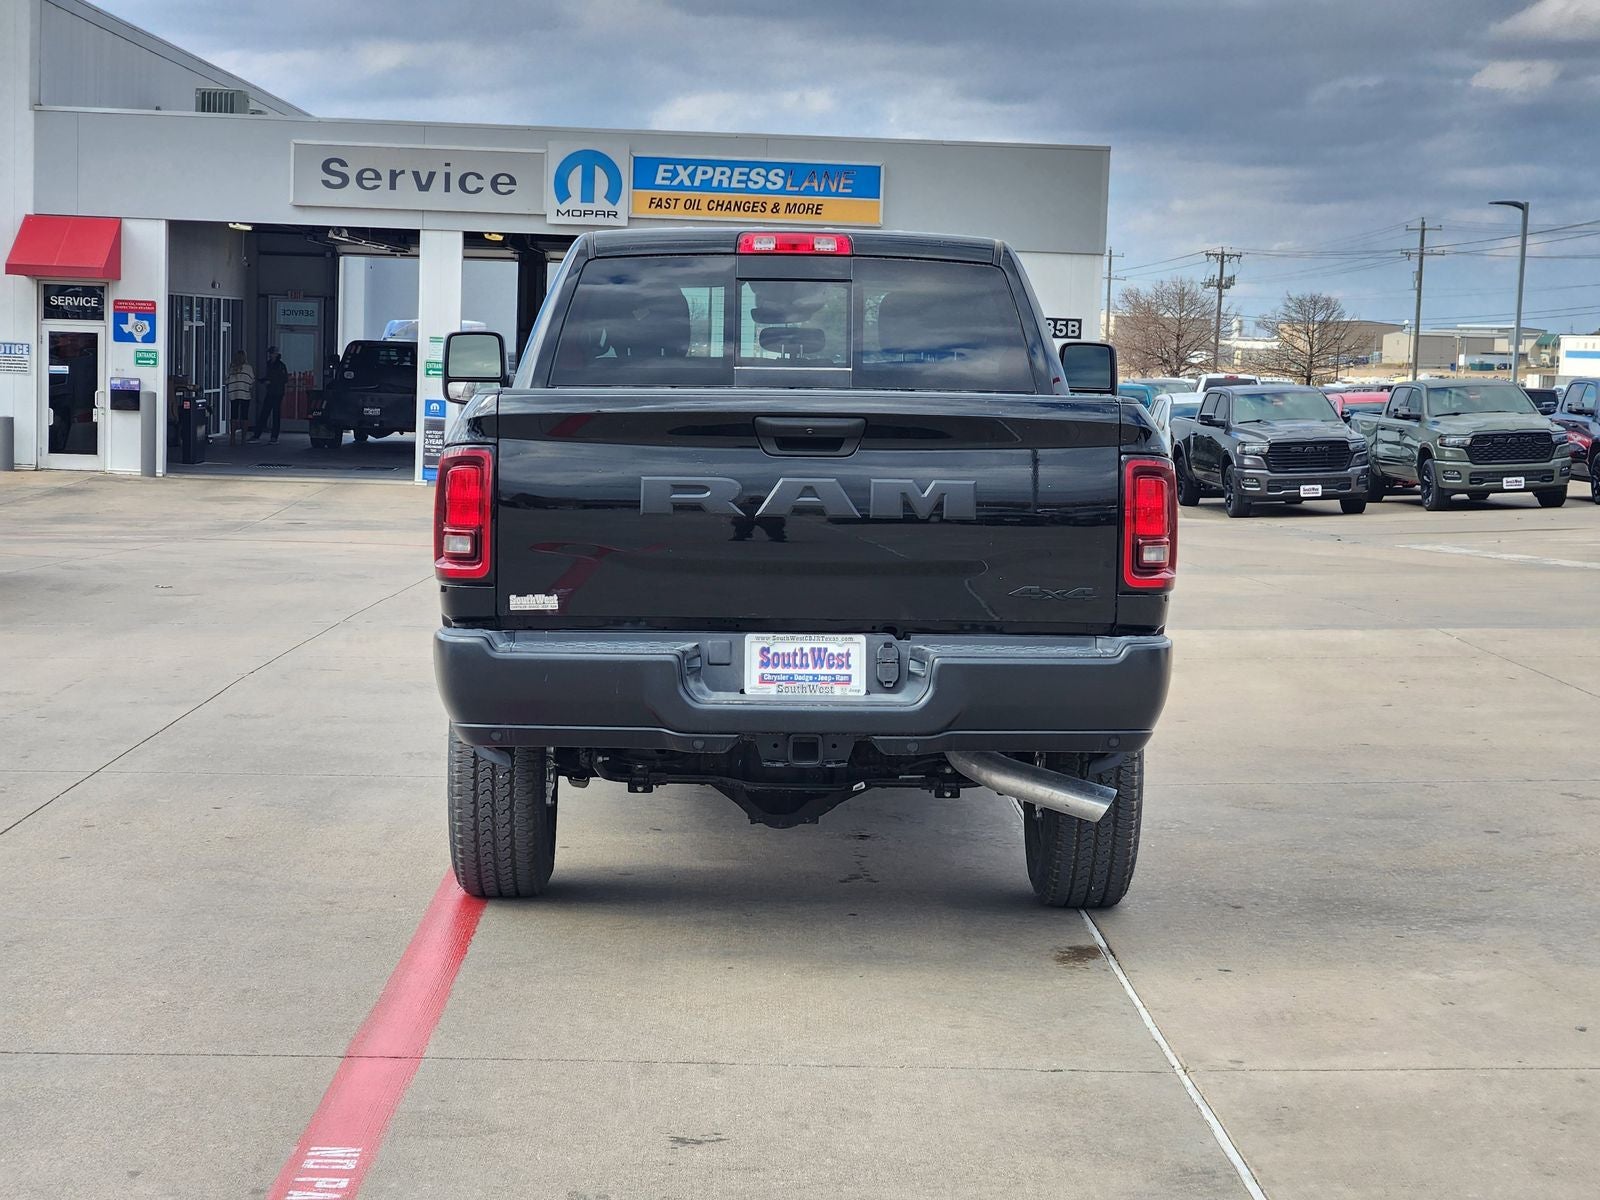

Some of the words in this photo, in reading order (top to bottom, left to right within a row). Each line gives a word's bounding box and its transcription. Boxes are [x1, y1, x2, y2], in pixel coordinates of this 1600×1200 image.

[321, 157, 517, 196] Service
[648, 197, 680, 210] FAST
[683, 198, 702, 211] OIL
[707, 199, 768, 213] CHANGES
[770, 203, 780, 214] &
[784, 202, 824, 215] MORE
[556, 208, 618, 219] MOPAR
[50, 295, 99, 307] SERVICE
[640, 476, 977, 520] RAM
[509, 594, 558, 604] SouthWest
[759, 645, 852, 670] SouthWest
[763, 674, 789, 682] Chrysler
[794, 674, 813, 682] Dodge
[818, 674, 832, 682] Jeep
[777, 684, 835, 694] SouthWest
